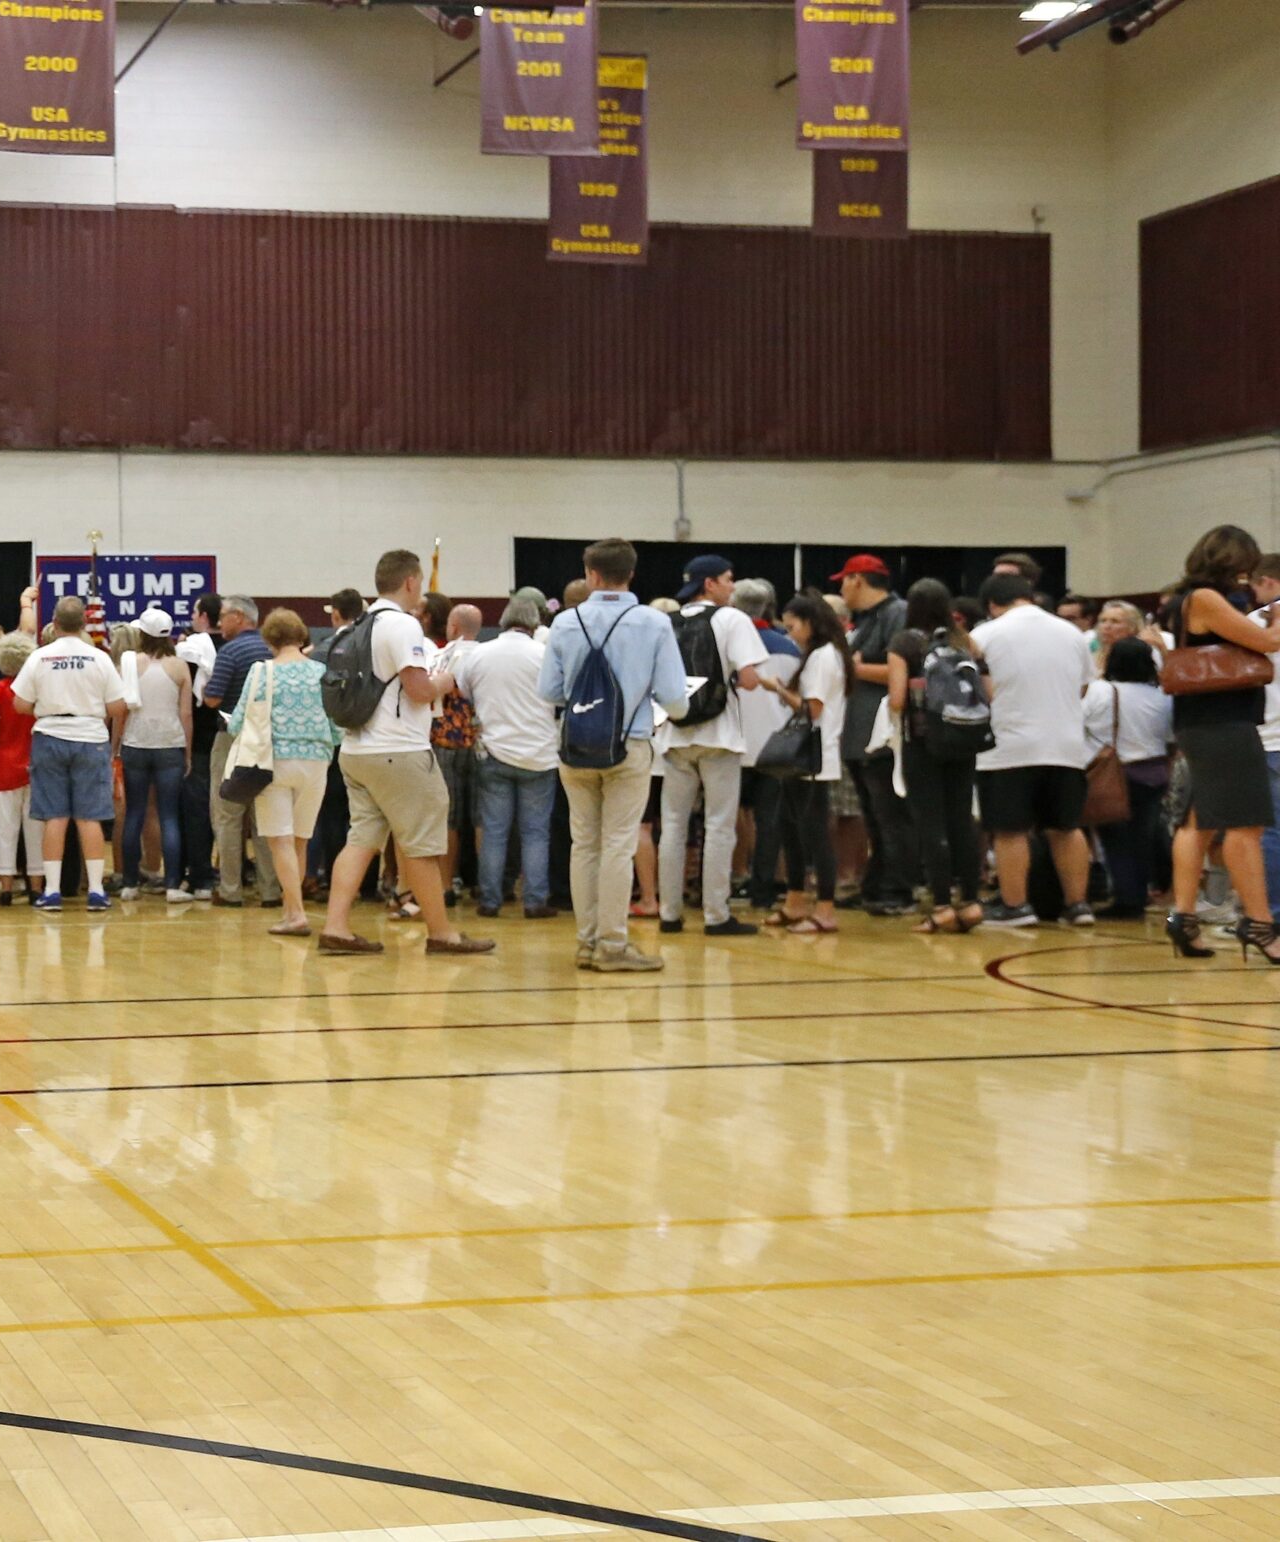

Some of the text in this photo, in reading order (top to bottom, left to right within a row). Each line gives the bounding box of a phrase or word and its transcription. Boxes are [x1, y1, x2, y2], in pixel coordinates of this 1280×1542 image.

[802, 6, 897, 25] Champions
[512, 27, 565, 44] Team
[24, 56, 78, 72] 2000
[517, 61, 562, 76] 2001
[829, 57, 874, 74] 2001
[31, 106, 70, 122] USA
[833, 105, 870, 121] USA
[502, 115, 576, 132] NCWSA
[802, 122, 902, 140] Gymnastics
[580, 224, 610, 238] USA
[551, 238, 641, 255] Gymnastics
[46, 573, 205, 597] TRUMP
[52, 661, 85, 670] 2016
